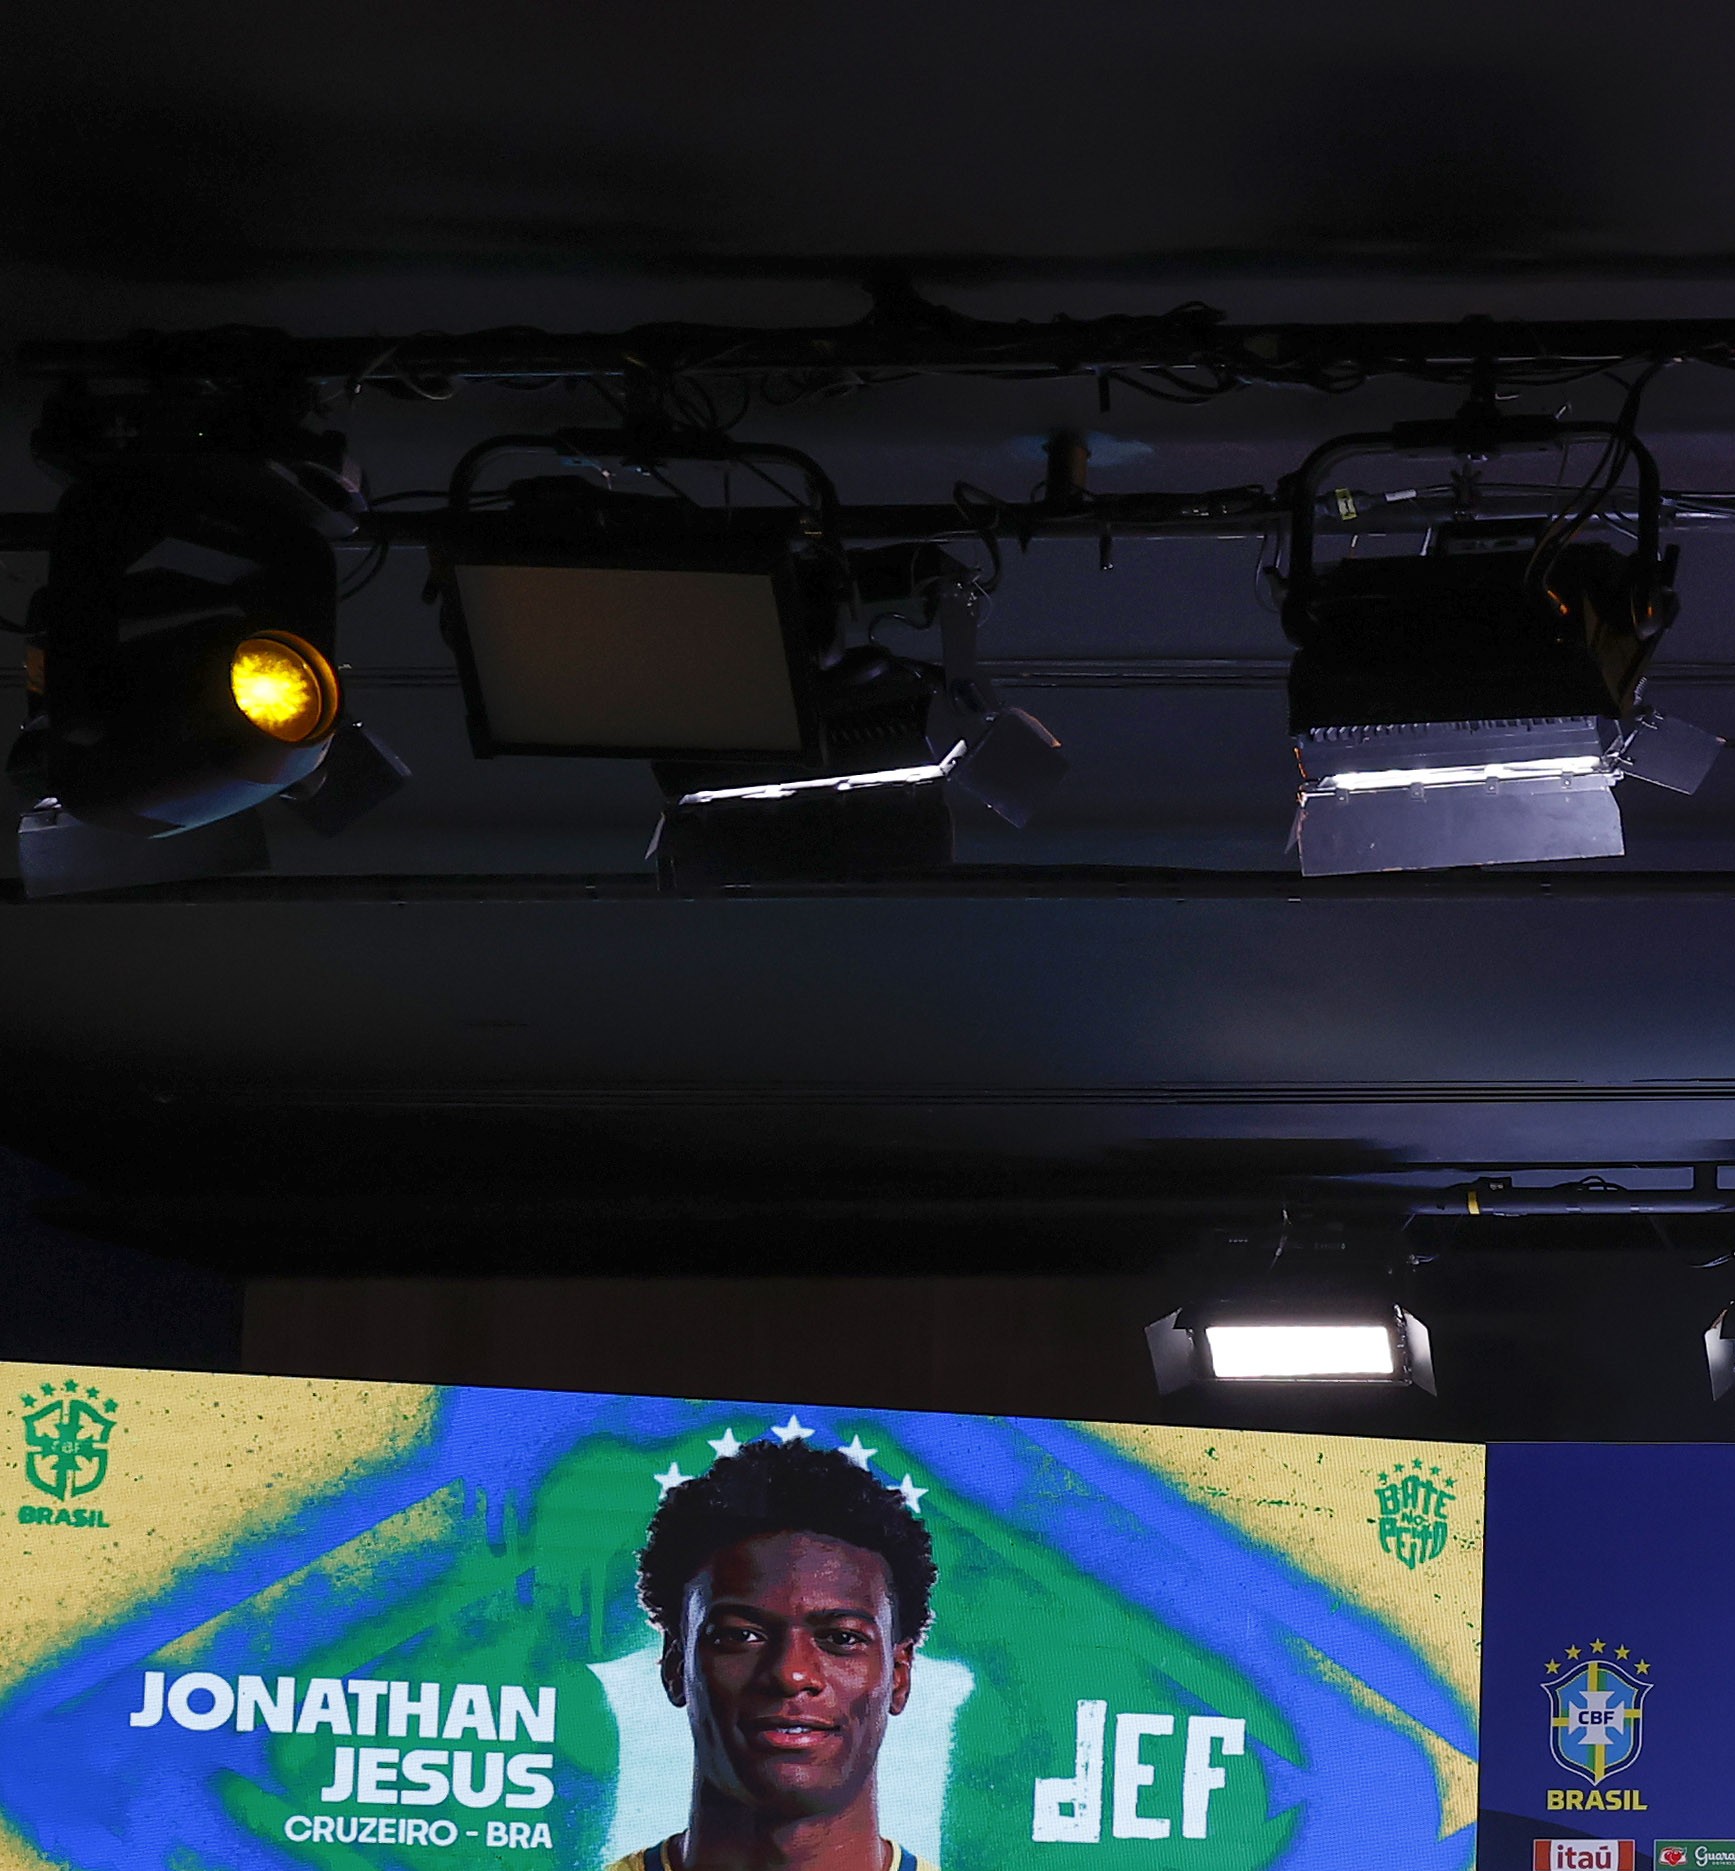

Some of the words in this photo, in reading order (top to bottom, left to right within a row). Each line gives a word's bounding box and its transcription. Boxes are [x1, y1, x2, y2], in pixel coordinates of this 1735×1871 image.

[1374, 1474, 1457, 1516] BATE
[18, 1505, 110, 1528] BRASIL
[130, 1672, 556, 1742] JONATHAN
[1579, 1711, 1614, 1724] CBF
[322, 1747, 554, 1808] JESUS
[1548, 1790, 1647, 1810] BRASIL
[285, 1816, 457, 1846] CRUZEIRO
[487, 1822, 552, 1849] BRA
[1558, 1845, 1611, 1869] itaú
